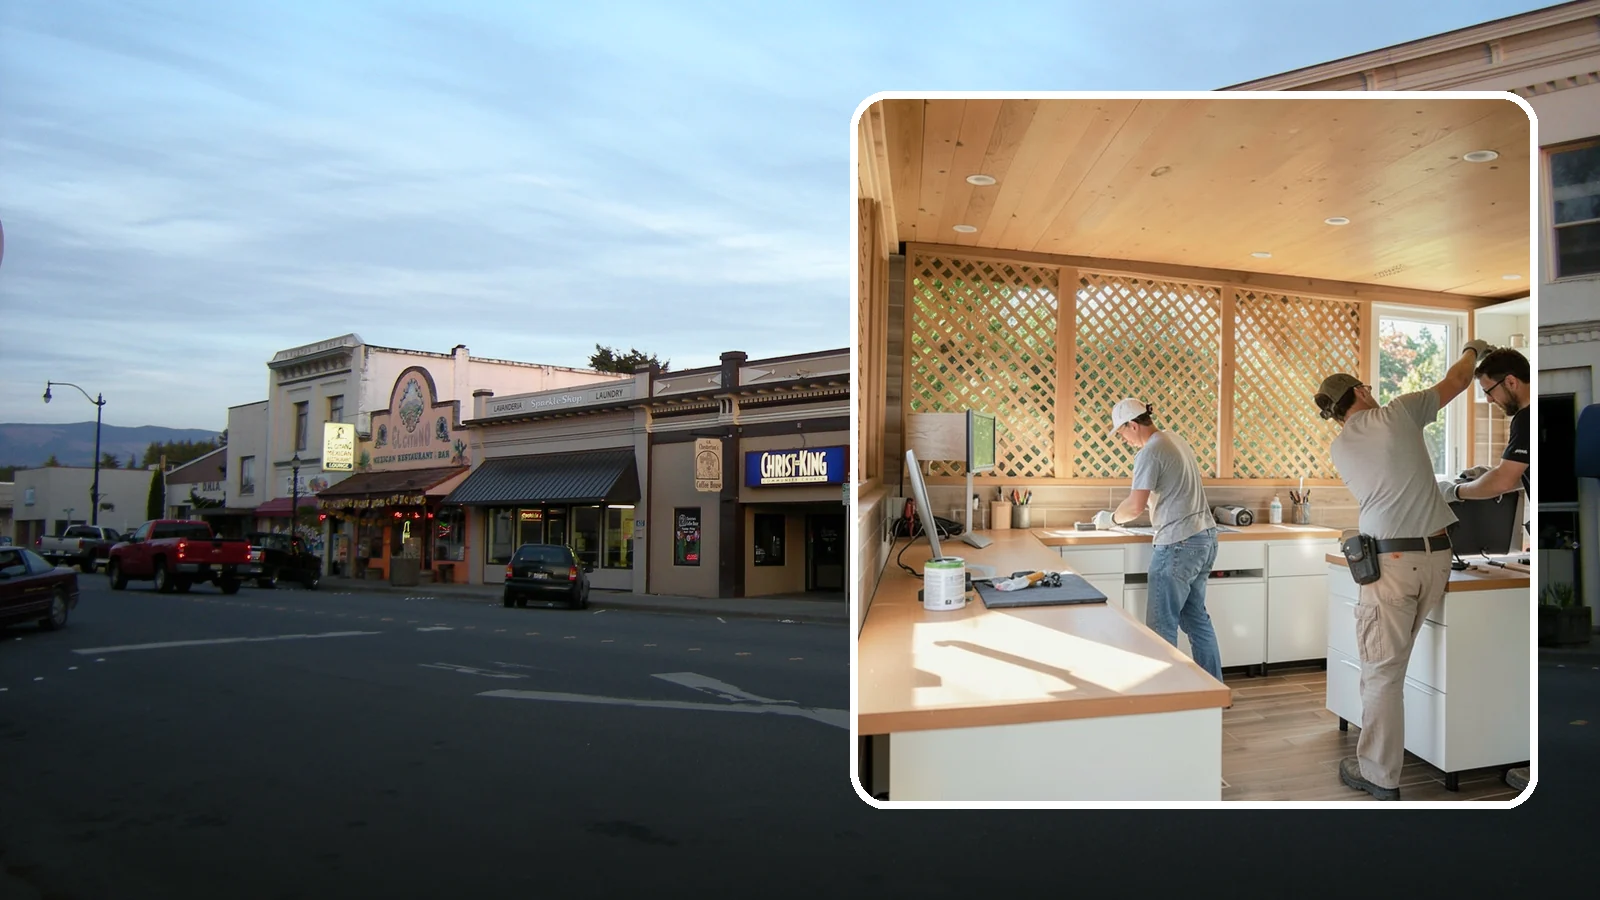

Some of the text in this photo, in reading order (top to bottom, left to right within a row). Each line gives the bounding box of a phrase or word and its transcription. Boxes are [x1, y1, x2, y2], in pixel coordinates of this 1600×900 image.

[595, 388, 624, 400] LAUNDRY
[493, 402, 523, 413] LAVANDERIA
[531, 394, 583, 410] Sparkle Shop
[373, 450, 450, 464] MEXICAN RESTAURANT BAR
[760, 449, 828, 478] CHRIST KING
[696, 481, 709, 489] Coffee
